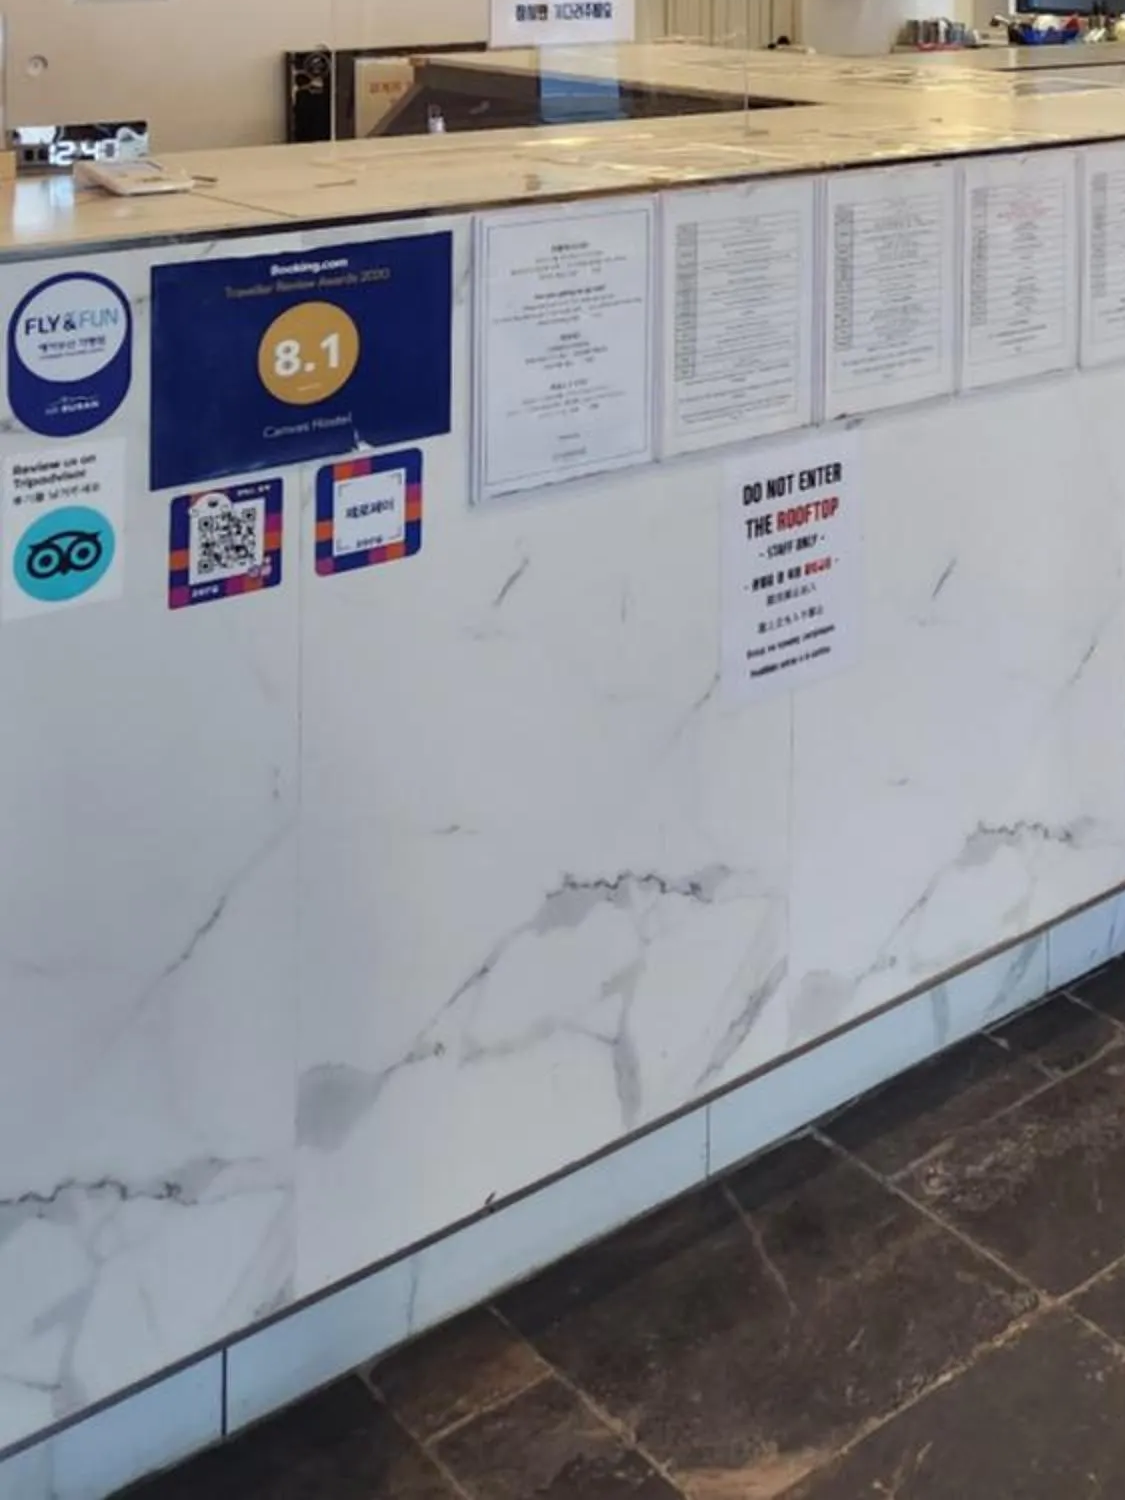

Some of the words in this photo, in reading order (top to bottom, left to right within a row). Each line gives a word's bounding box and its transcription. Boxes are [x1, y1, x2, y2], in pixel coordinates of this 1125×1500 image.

[270, 257, 349, 277] Booking.com
[274, 331, 341, 377] 8.1
[12, 461, 60, 476] Review
[743, 482, 762, 506] DO
[766, 473, 794, 500] NOT
[799, 462, 842, 492] ENTER
[745, 513, 773, 540] THE
[776, 496, 839, 532] ROOFTOP
